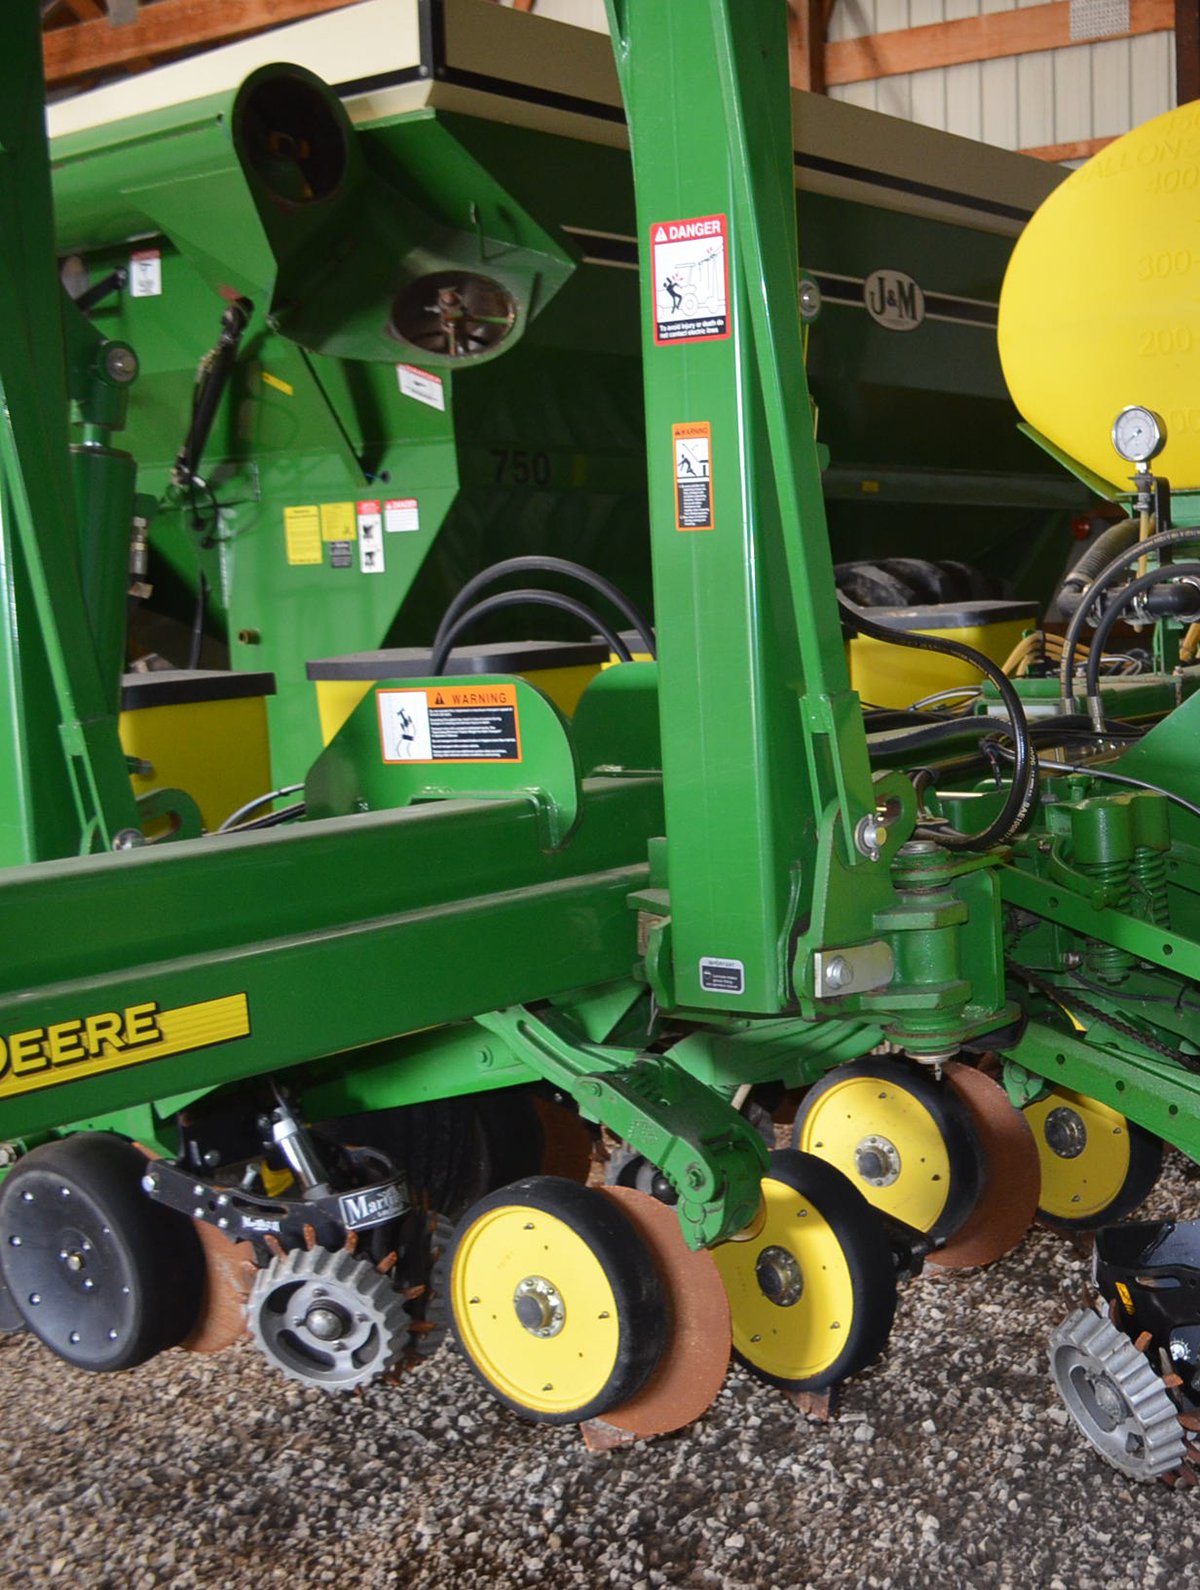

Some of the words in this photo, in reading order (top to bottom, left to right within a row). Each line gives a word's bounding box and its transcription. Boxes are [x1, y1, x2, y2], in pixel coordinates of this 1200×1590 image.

[1146, 165, 1199, 194] 400
[669, 221, 721, 240] DANGER
[1137, 249, 1192, 281] 300
[869, 276, 918, 321] J&M
[1138, 327, 1193, 357] 200
[490, 449, 551, 485] 750
[452, 692, 507, 705] WARNING
[0, 1002, 160, 1079] EERE
